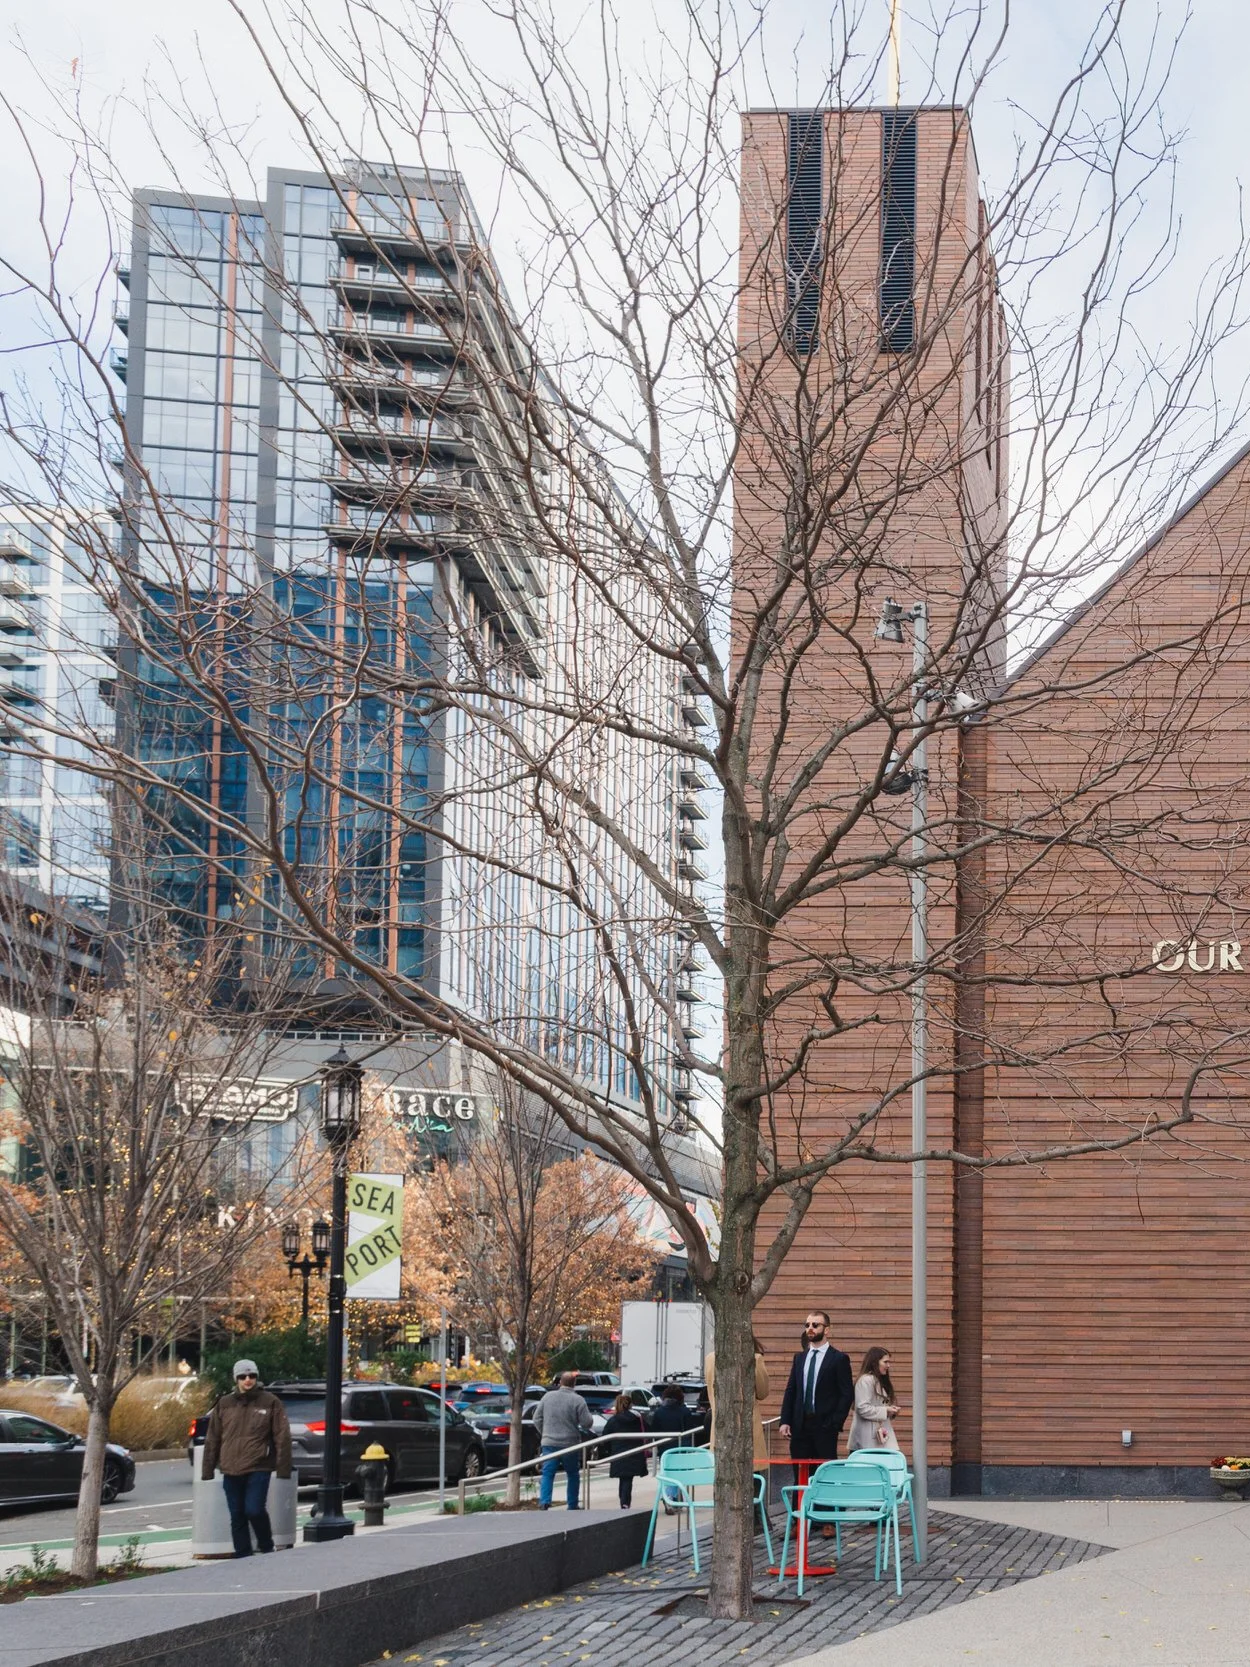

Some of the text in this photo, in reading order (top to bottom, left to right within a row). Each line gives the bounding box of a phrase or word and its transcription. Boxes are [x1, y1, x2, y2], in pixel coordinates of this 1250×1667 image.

[1152, 939, 1244, 972] OUR
[352, 1183, 395, 1216] SEA
[345, 1224, 402, 1277] PORT
